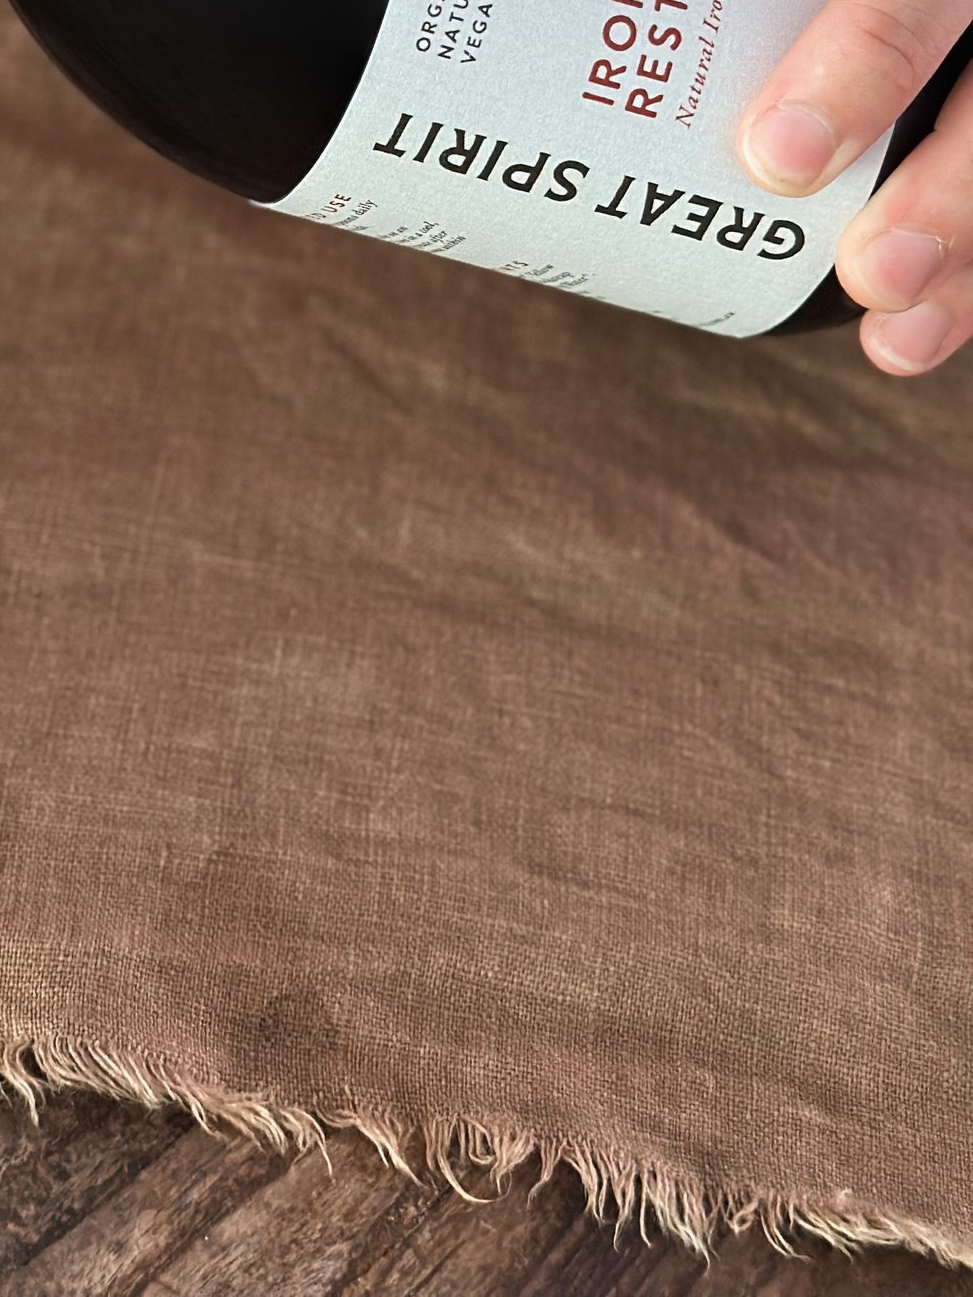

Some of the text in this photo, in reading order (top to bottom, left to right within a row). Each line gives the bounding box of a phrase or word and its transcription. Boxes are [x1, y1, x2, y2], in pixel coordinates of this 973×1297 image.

[674, 35, 715, 130] Natural
[321, 194, 352, 213] USE
[351, 199, 378, 216] daily
[372, 113, 806, 261] GREAT SPIRIT
